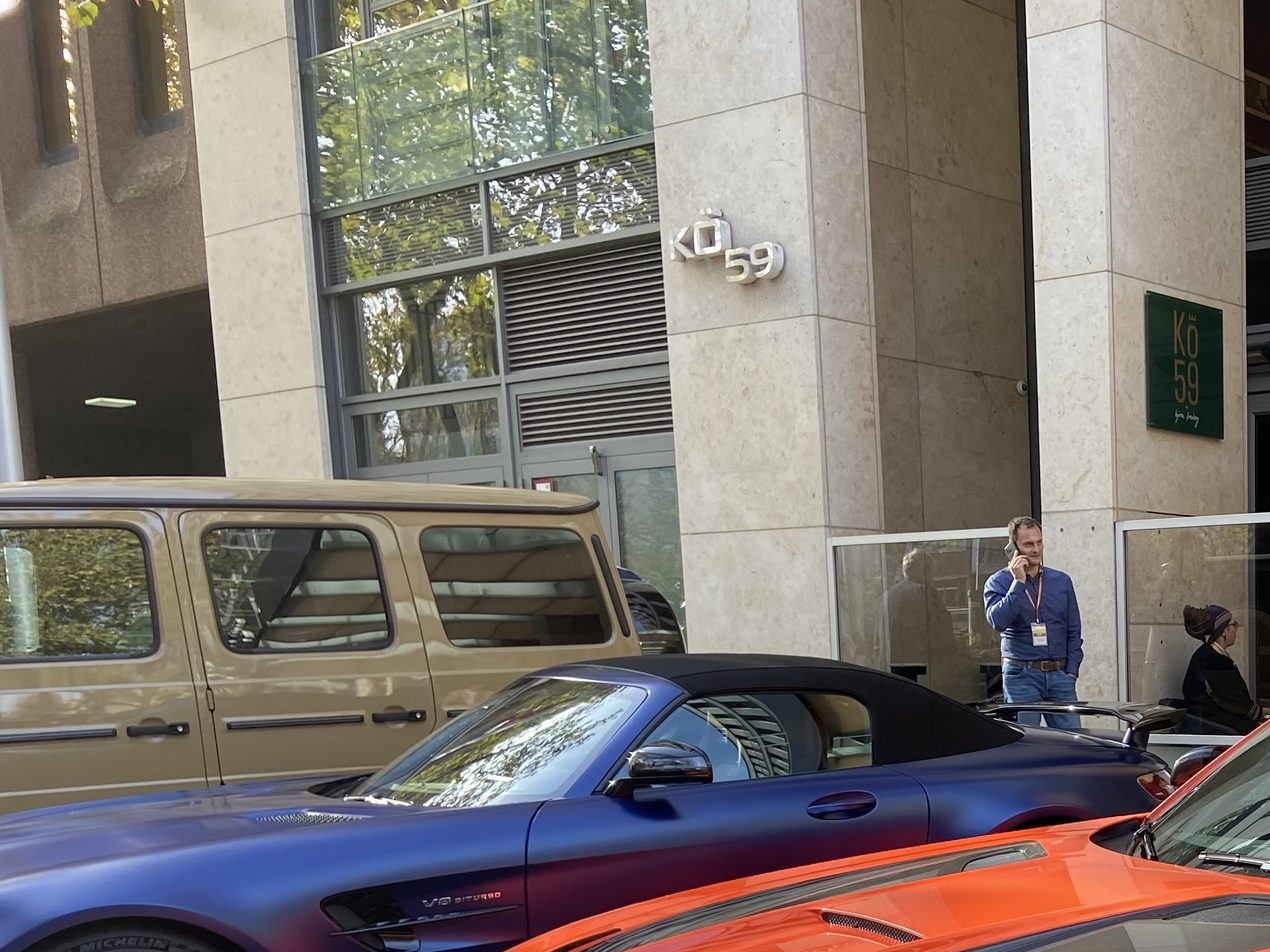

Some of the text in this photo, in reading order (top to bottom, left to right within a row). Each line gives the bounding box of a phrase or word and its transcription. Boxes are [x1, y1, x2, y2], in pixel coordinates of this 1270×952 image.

[725, 242, 784, 284] 59
[1174, 359, 1199, 406] 59
[80, 937, 169, 952] MICHELIN
